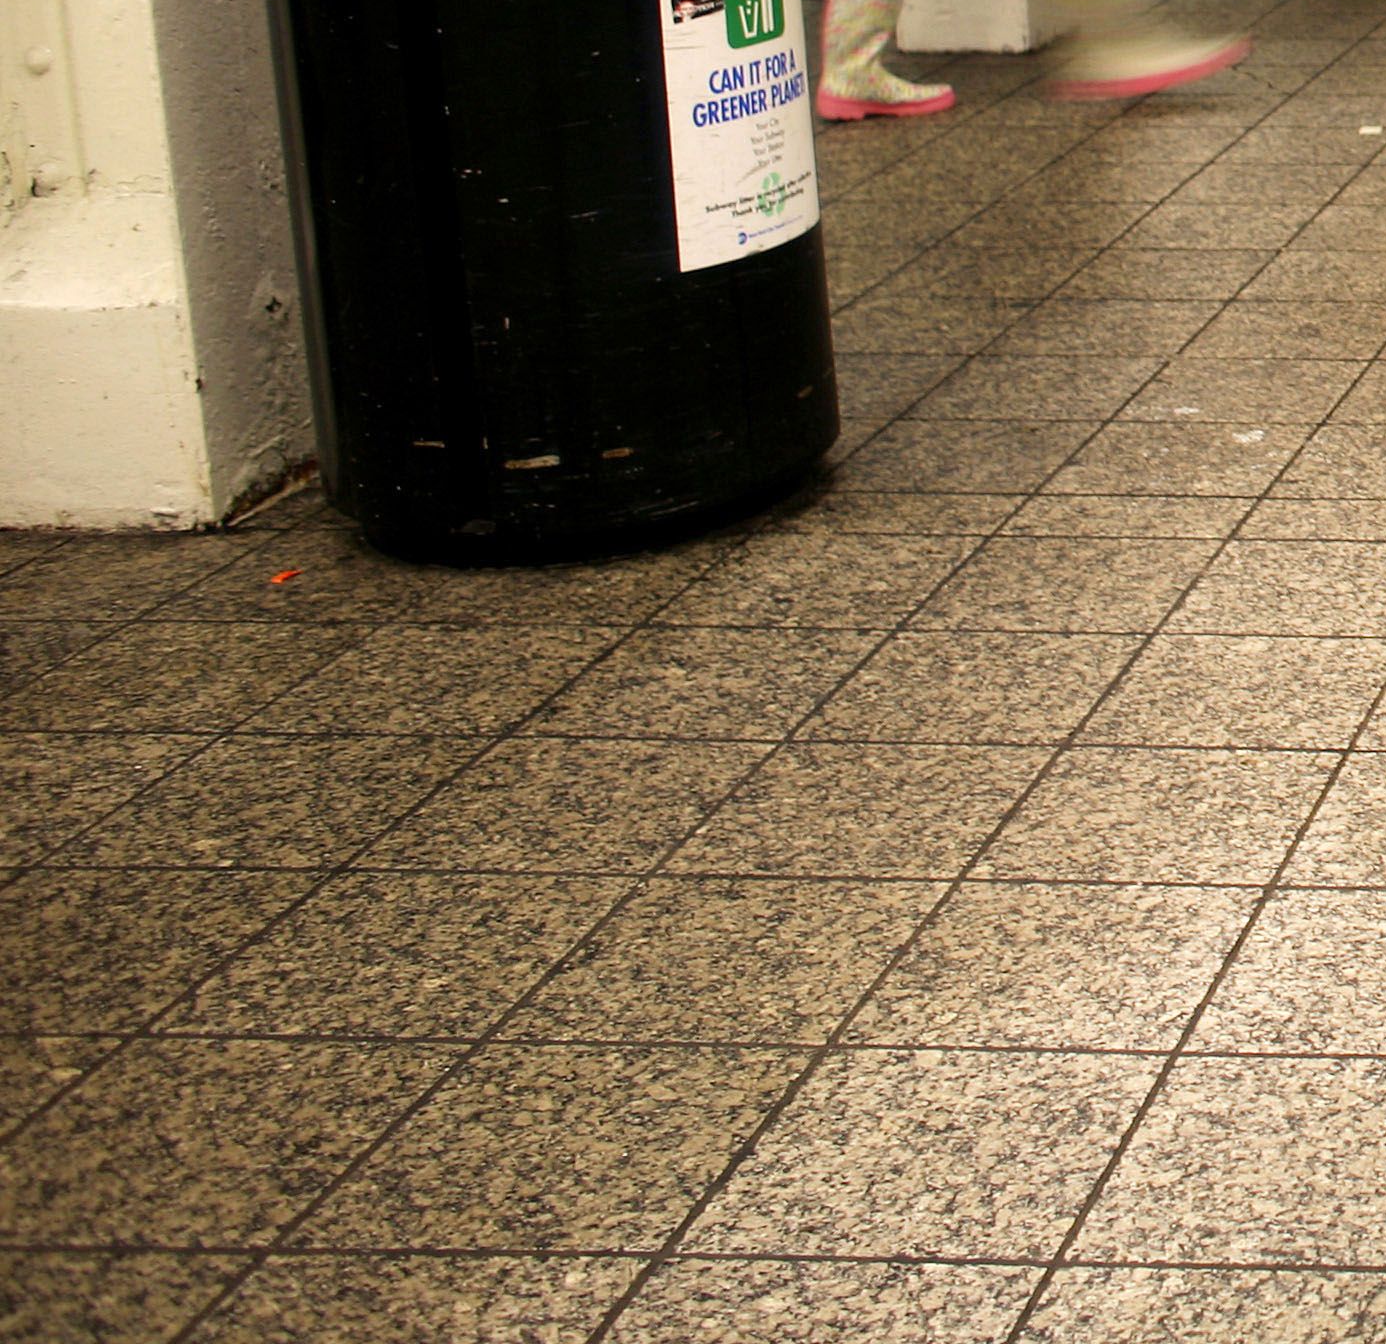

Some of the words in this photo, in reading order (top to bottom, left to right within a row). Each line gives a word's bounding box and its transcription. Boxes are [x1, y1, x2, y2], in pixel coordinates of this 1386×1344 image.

[709, 64, 744, 94] CAN
[749, 60, 762, 85] IT
[765, 52, 788, 81] FOR
[789, 48, 796, 72] A
[692, 88, 768, 128] GREENER
